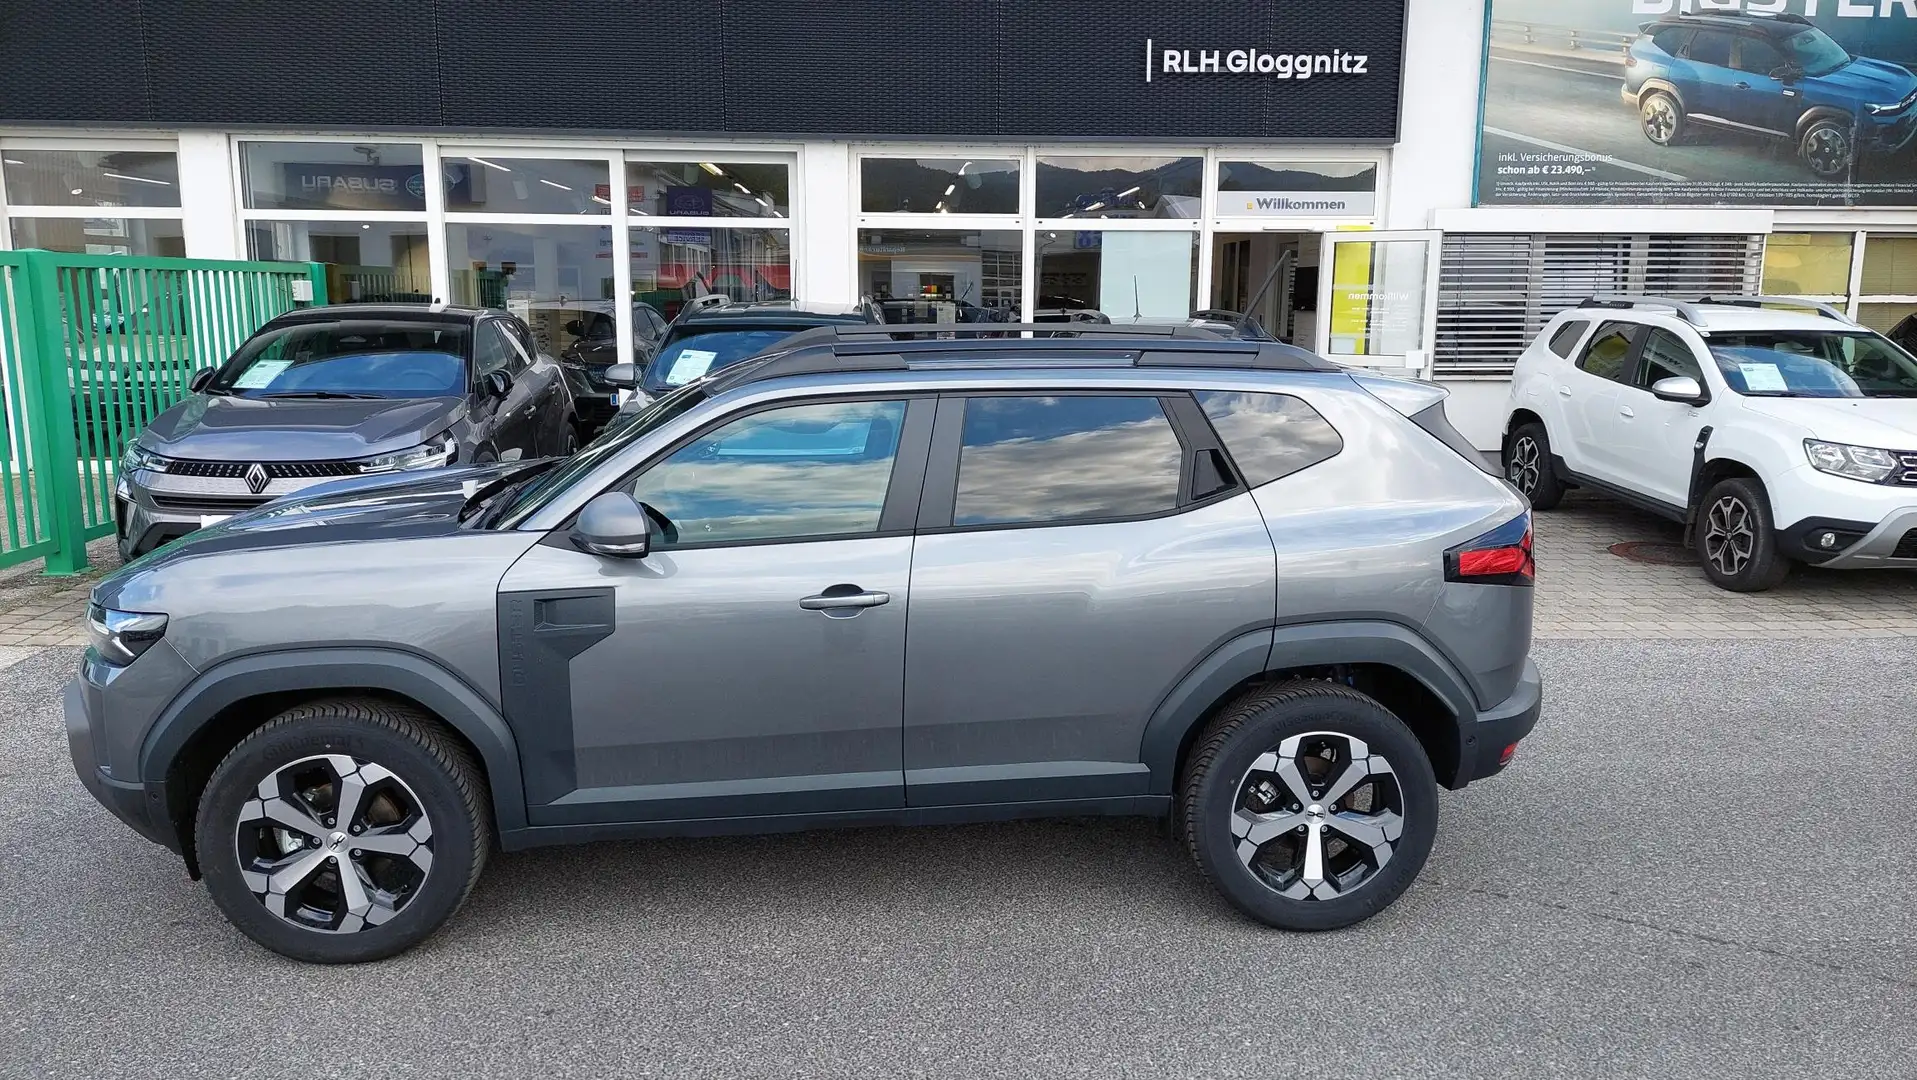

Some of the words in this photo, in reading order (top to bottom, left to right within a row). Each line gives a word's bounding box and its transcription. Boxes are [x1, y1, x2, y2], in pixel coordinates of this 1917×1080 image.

[1163, 50, 1220, 73] RLH
[1226, 48, 1368, 79] Gloggnitz
[1498, 152, 1518, 162] inkl.
[1520, 152, 1613, 164] Versicherungsbonus
[1497, 165, 1526, 175] schon
[1527, 165, 1540, 175] ab
[1542, 165, 1549, 175] €
[1256, 197, 1346, 210] Willkommen
